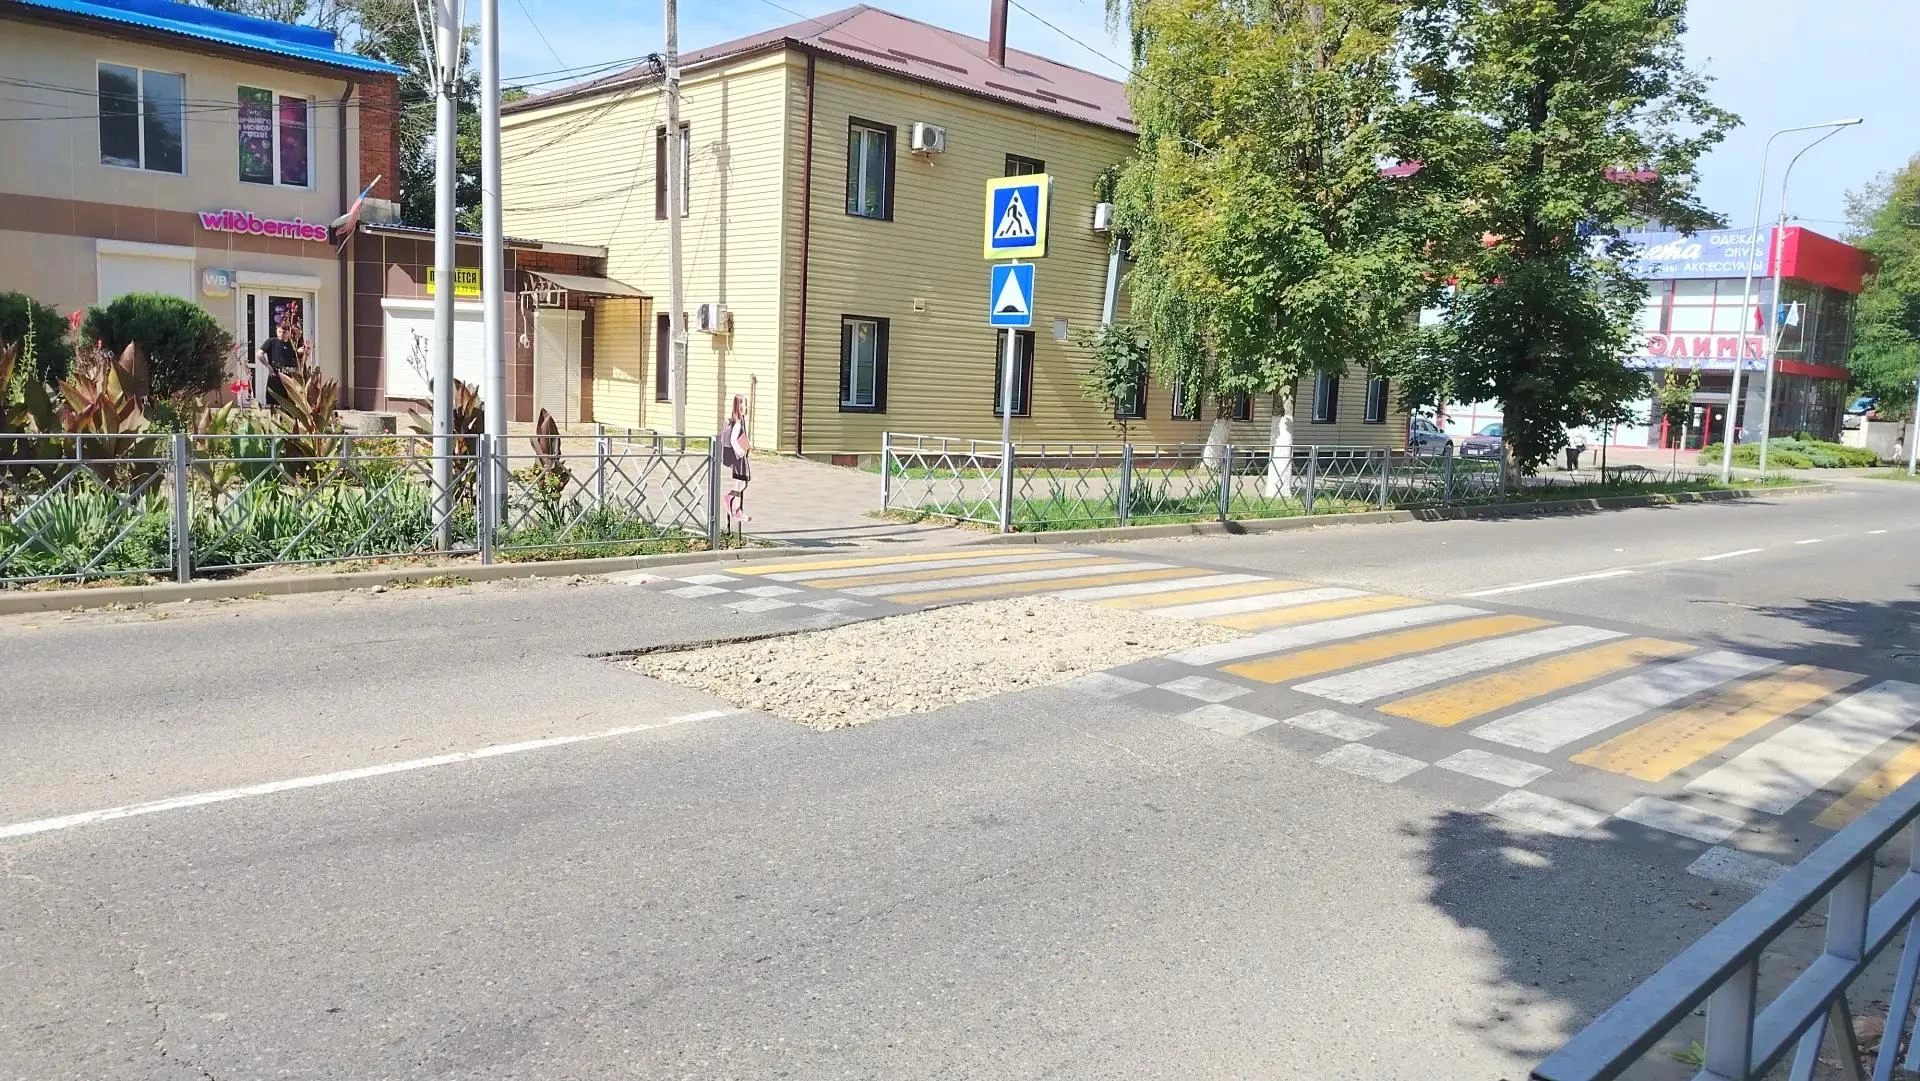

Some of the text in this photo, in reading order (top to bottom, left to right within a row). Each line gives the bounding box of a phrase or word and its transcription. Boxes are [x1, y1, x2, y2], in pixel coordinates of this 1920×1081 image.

[200, 210, 327, 241] wildberries
[1725, 247, 1764, 257] ОБУЬ
[205, 275, 227, 286] WB
[430, 269, 477, 284] ПЁТСЯ
[1647, 335, 1764, 360] ОЛИМП
